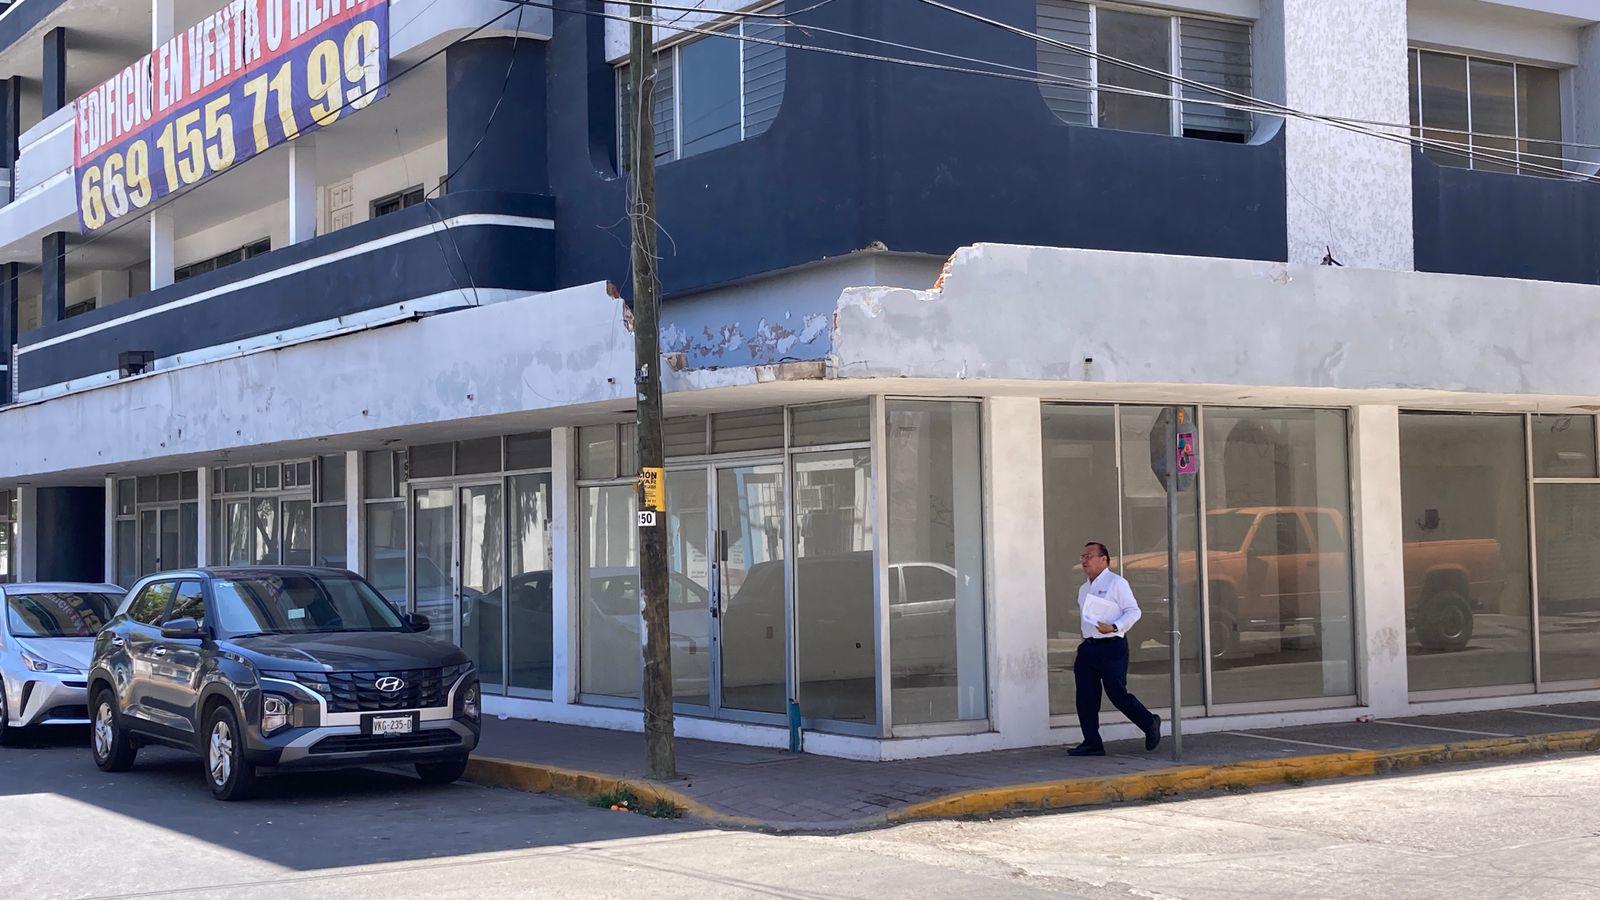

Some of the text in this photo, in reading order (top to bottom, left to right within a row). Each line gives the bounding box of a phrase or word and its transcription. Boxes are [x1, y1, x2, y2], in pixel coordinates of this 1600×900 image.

[79, 55, 153, 158] EDIFICIO
[159, 34, 183, 111] EN
[188, 0, 261, 94] VENTA
[81, 140, 152, 229] 669
[156, 93, 235, 193] 155
[244, 61, 299, 154] 71
[307, 20, 380, 126] 99
